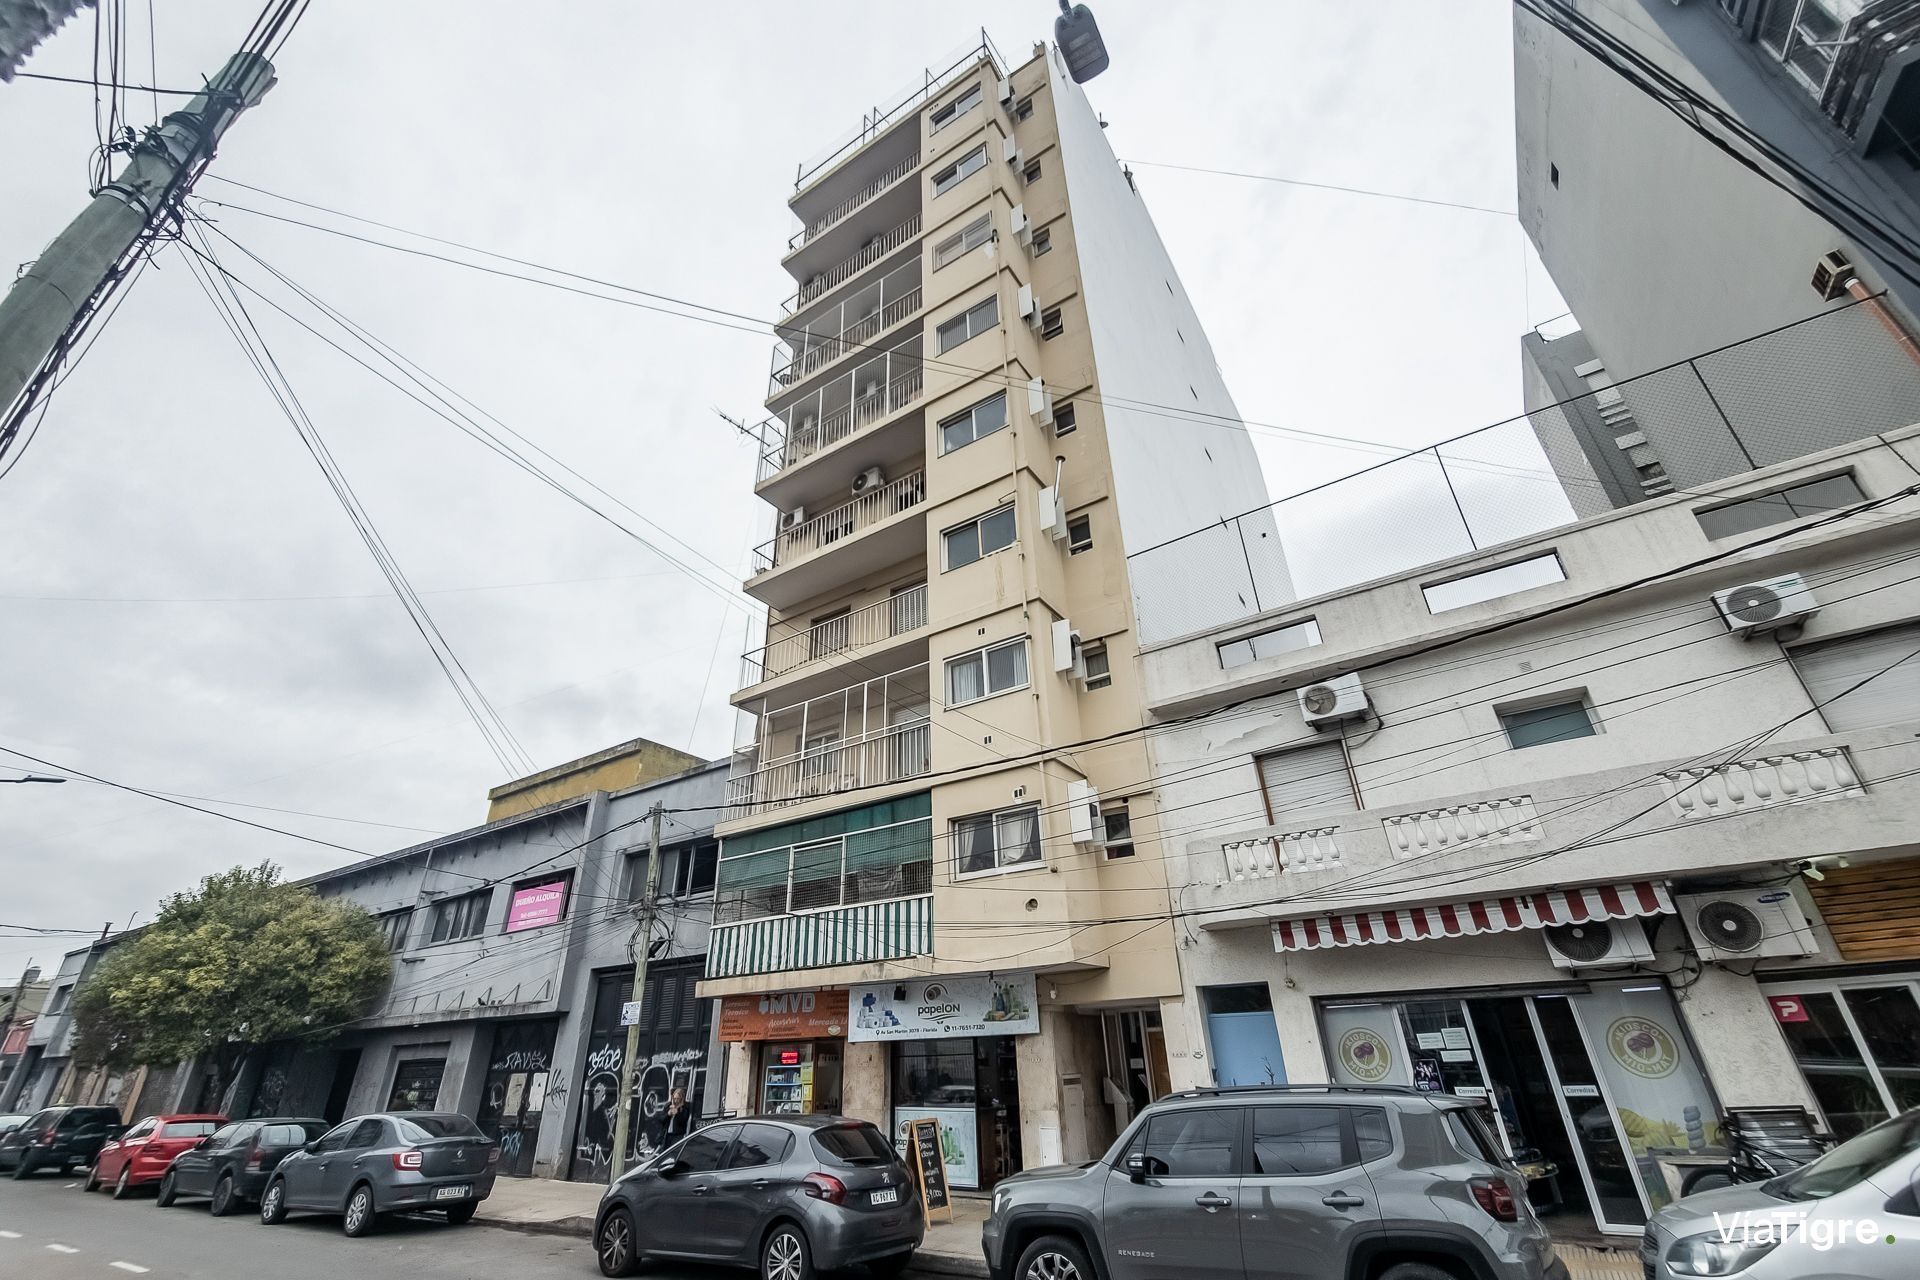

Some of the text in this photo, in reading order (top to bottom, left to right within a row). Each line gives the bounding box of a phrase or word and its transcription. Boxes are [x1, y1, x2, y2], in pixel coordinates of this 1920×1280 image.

[917, 1003, 960, 1016] papelON
[1615, 1022, 1659, 1038] KIOSCO
[1346, 1033, 1379, 1046] KIOSCO
[1118, 1249, 1155, 1258] RENEGADE
